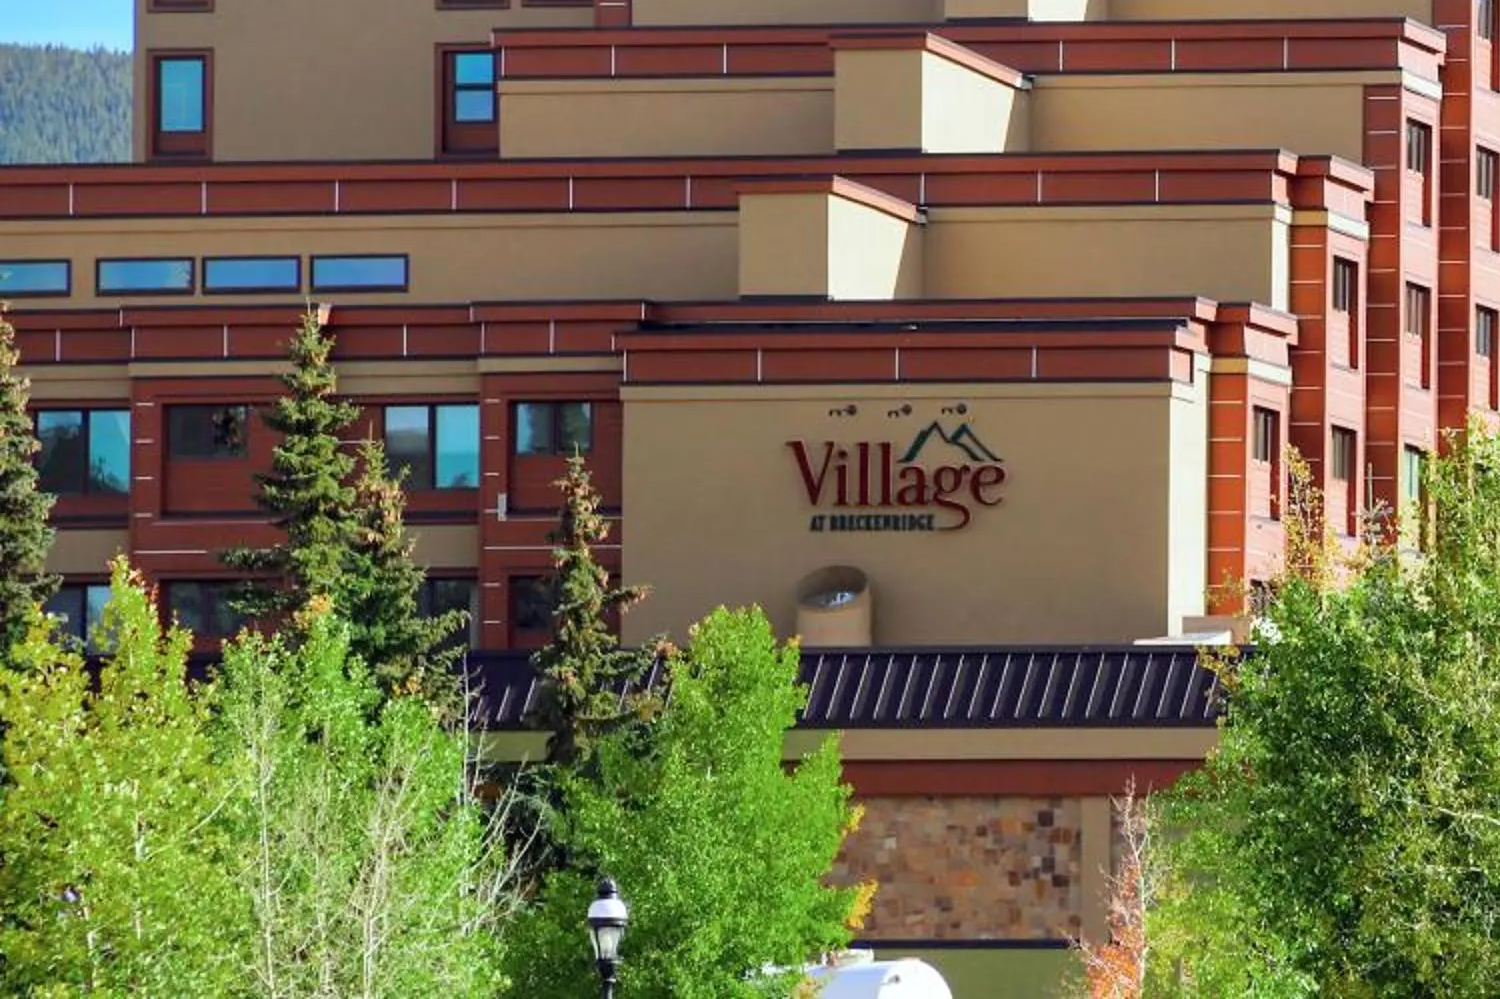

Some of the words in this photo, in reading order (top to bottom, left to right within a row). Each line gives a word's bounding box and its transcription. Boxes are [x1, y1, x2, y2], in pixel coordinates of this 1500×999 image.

[786, 440, 1005, 532] Village
[810, 514, 826, 532] AT
[830, 514, 935, 532] BRECKENRIDGE
